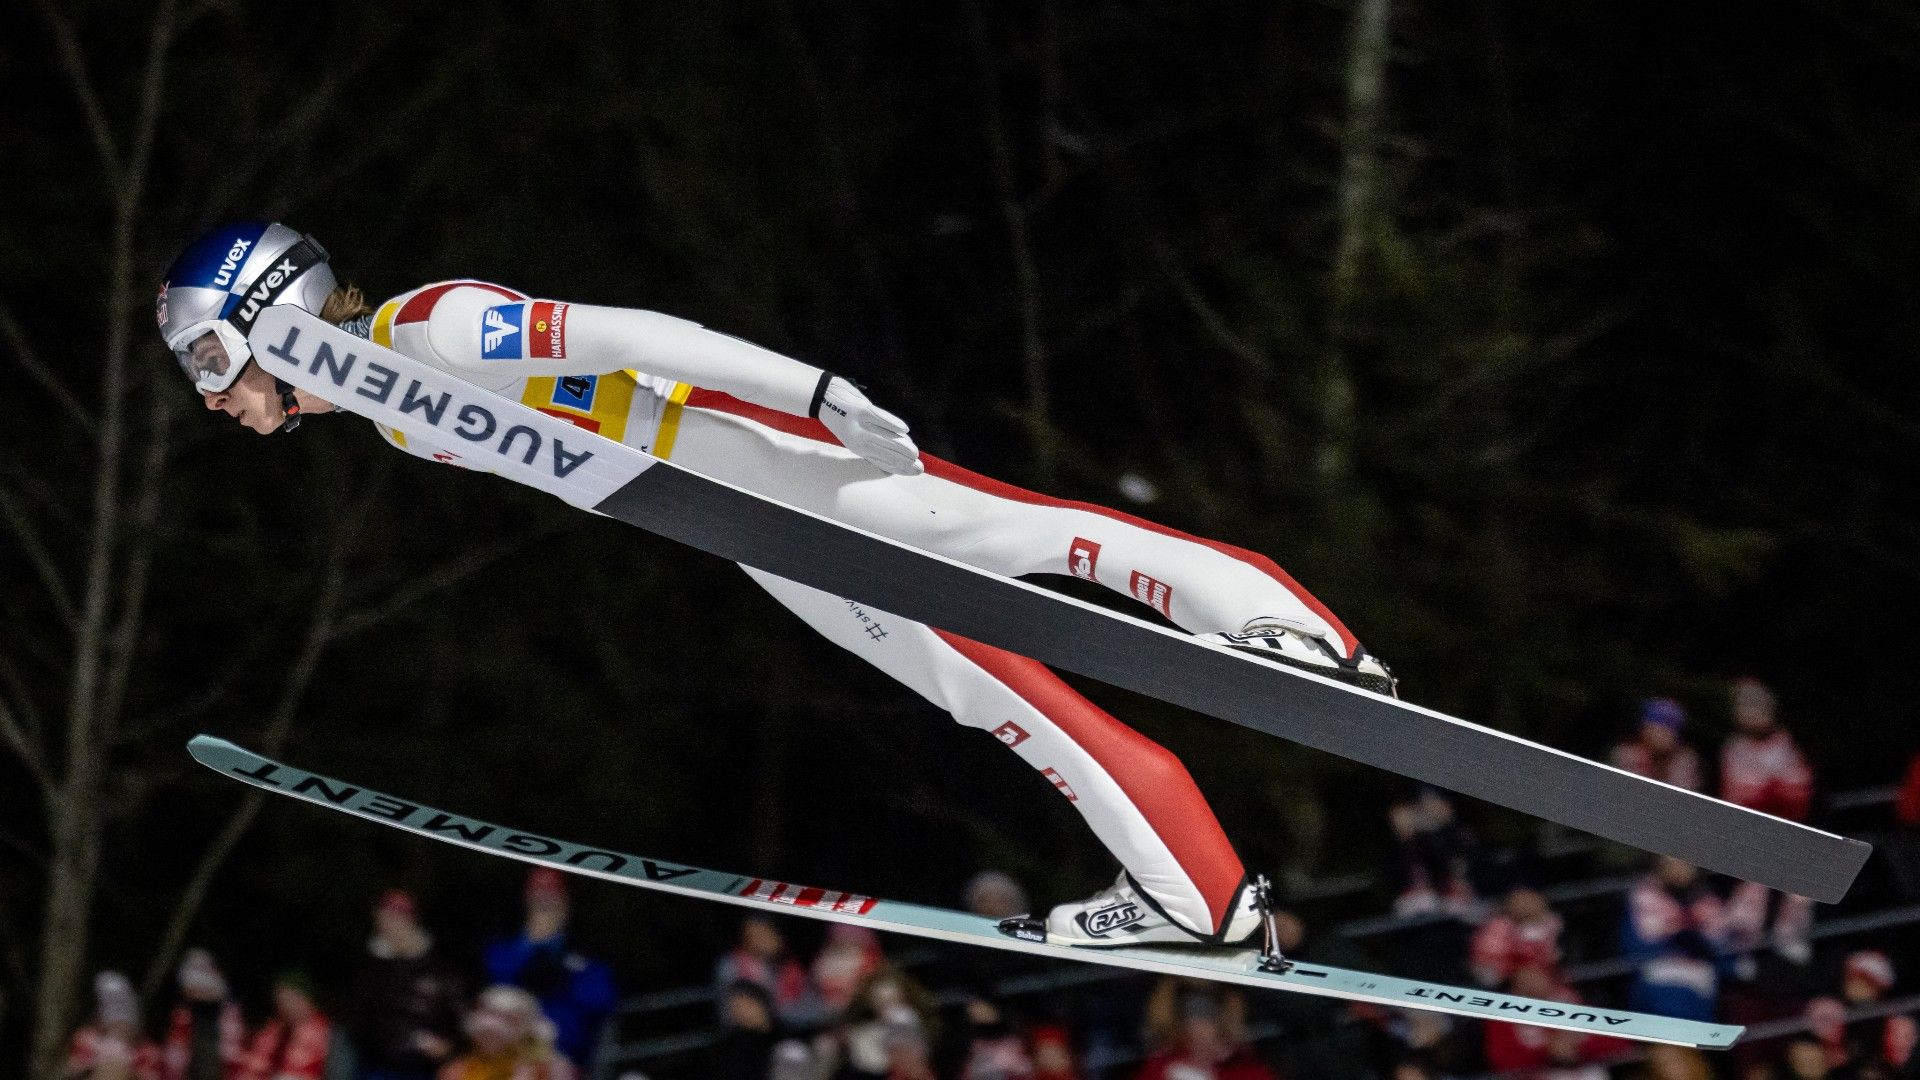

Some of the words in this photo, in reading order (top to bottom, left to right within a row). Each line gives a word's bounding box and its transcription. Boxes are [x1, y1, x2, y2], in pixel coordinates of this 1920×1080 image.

[214, 238, 251, 287] uvex
[239, 258, 298, 322] uvex
[268, 326, 595, 479] AUGMENT
[232, 763, 700, 882] AUGMENT
[1404, 986, 1633, 1026] AUGMENT
